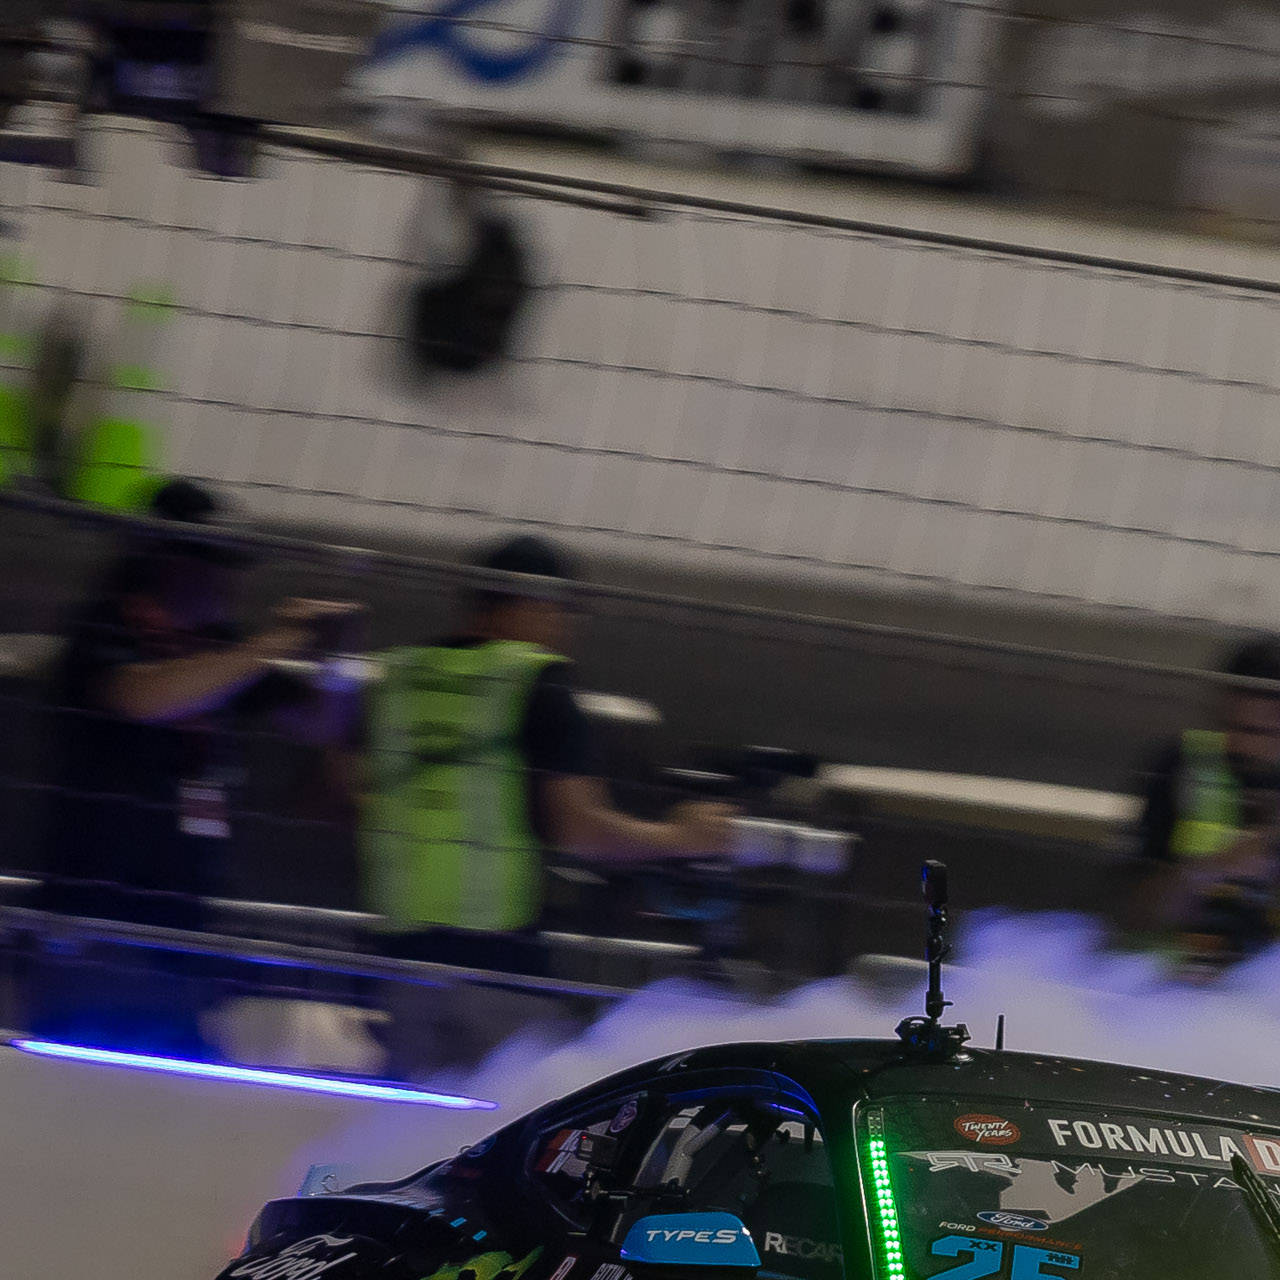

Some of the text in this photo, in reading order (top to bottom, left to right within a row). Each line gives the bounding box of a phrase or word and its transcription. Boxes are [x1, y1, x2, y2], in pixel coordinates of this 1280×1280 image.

[1047, 1119, 1239, 1161] FORMULA
[939, 1221, 976, 1232] FORD
[990, 1212, 1036, 1229] Ford
